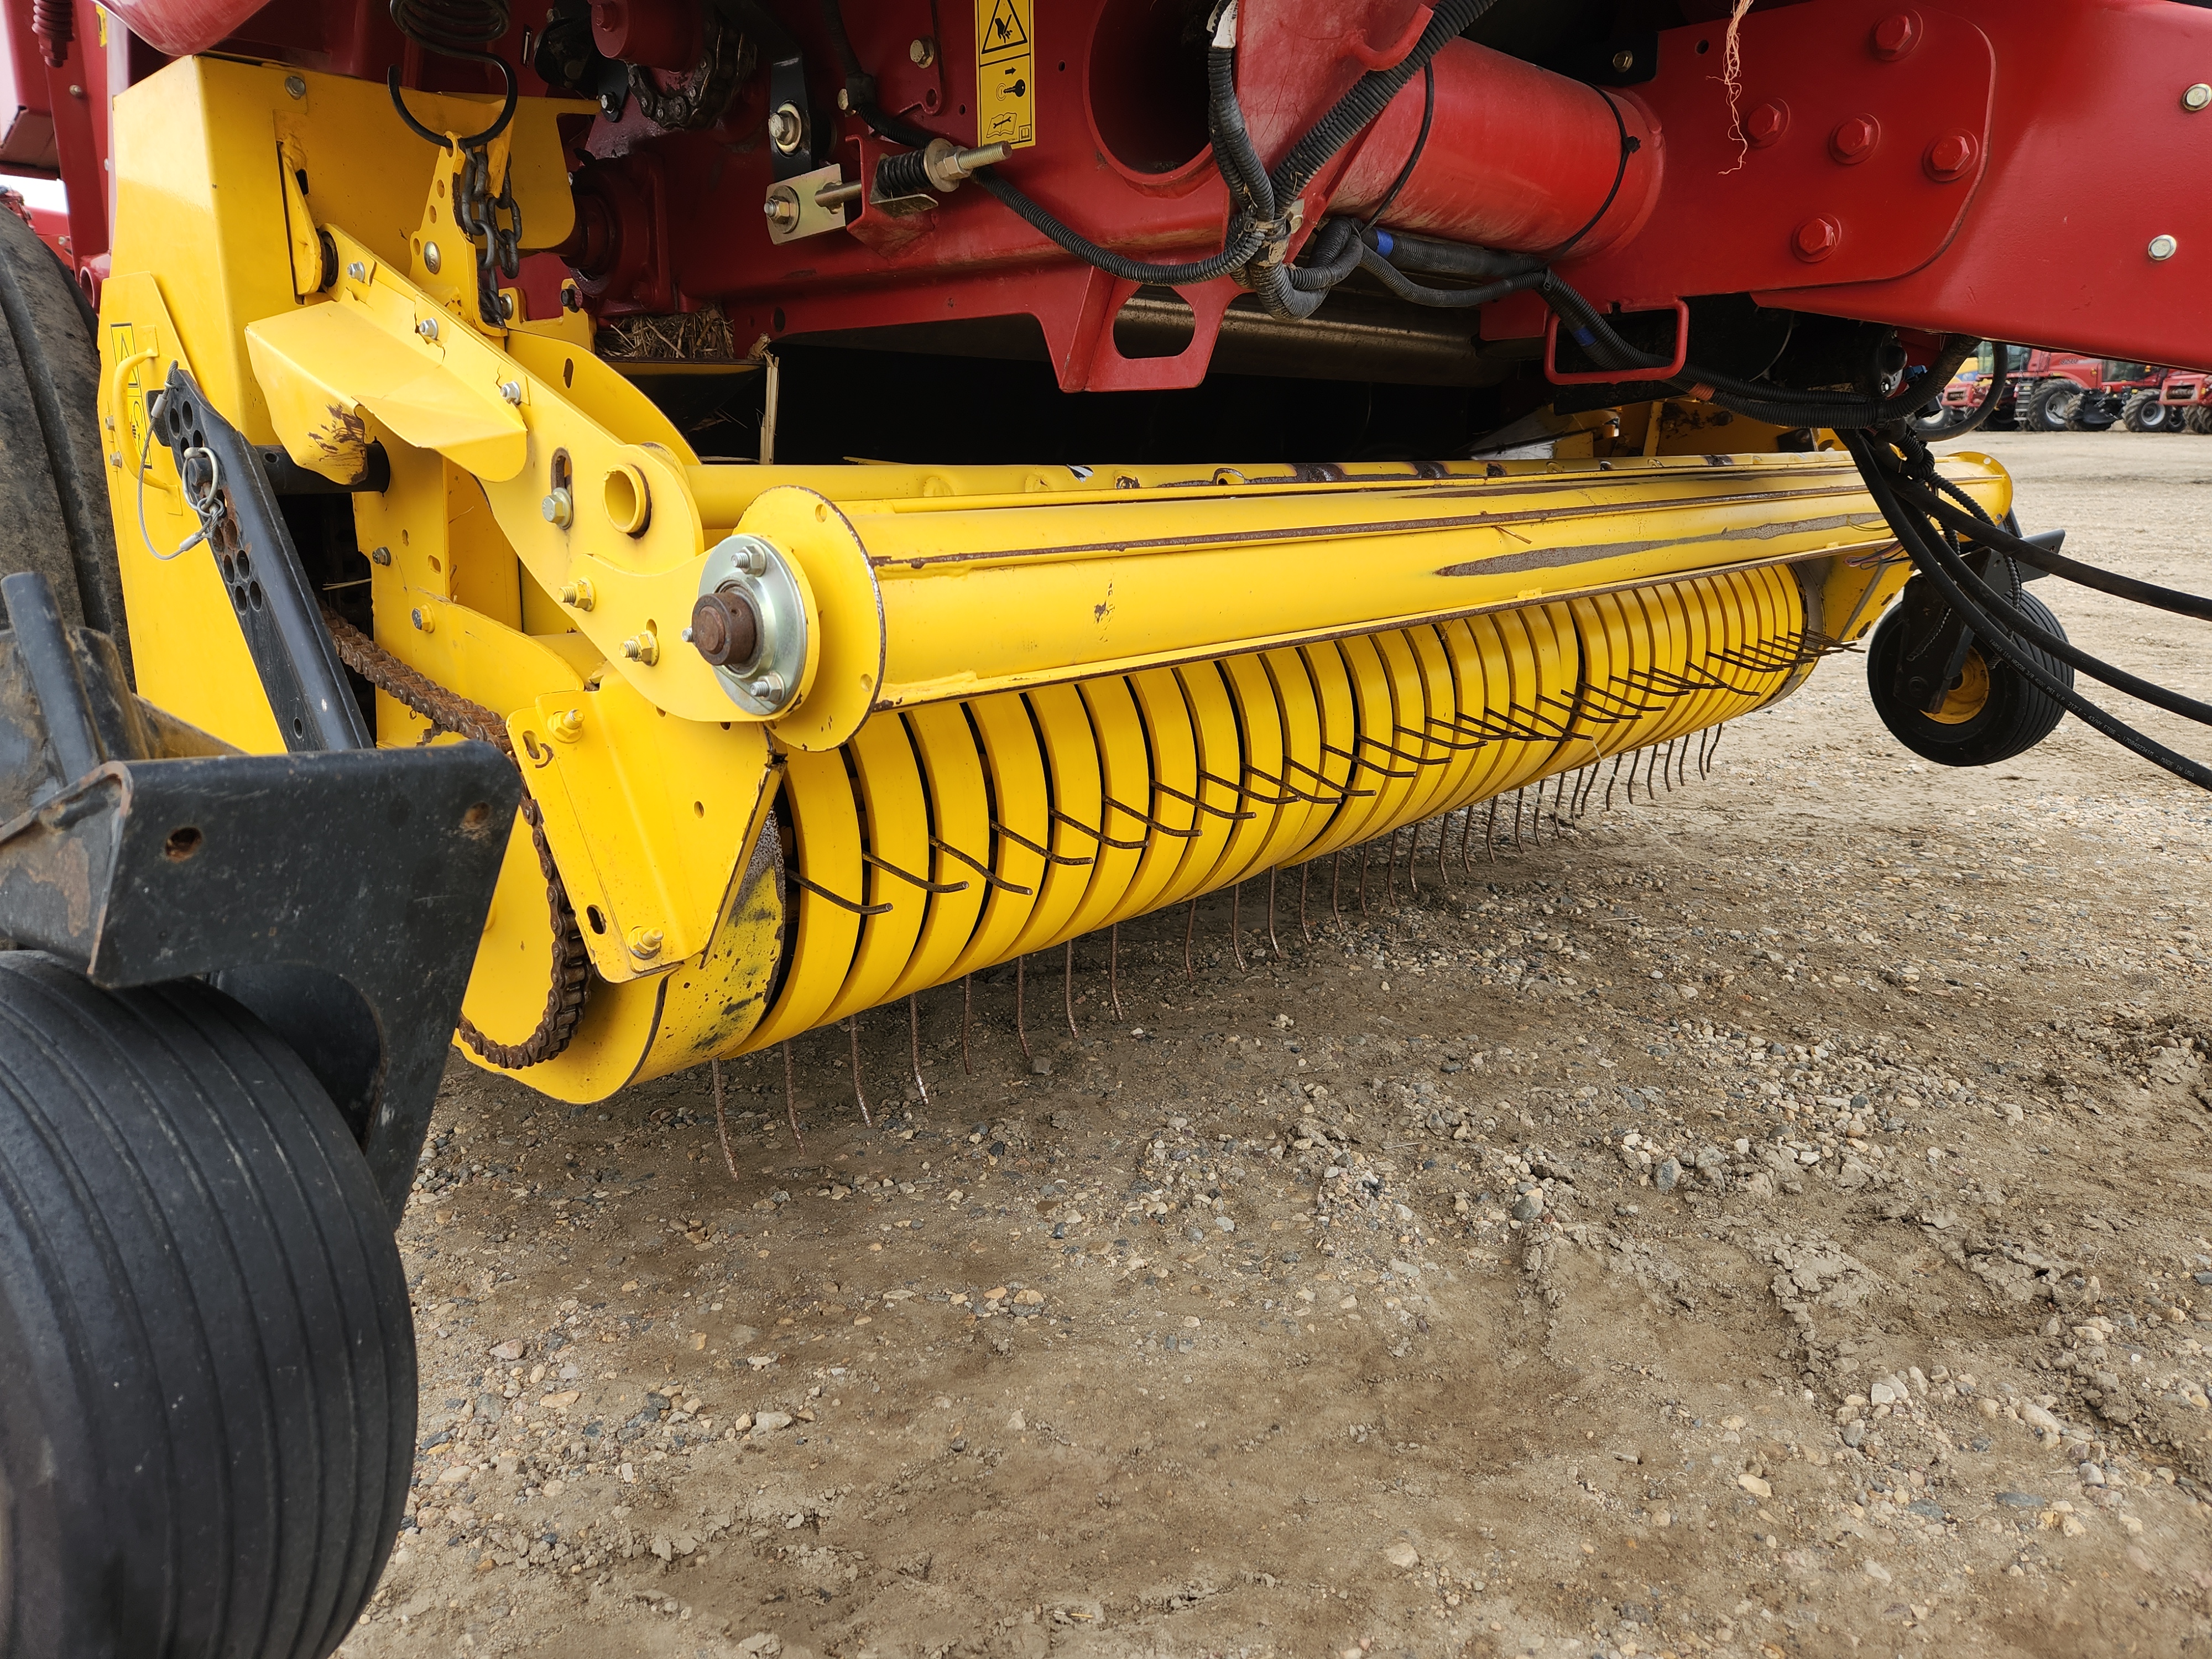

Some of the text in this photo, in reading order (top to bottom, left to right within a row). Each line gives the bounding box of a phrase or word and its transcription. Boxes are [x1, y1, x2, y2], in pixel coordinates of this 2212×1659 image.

[2026, 671, 2034, 679] 3/8
[2035, 679, 2046, 687] 4000
[2046, 686, 2056, 695] PSI
[2088, 716, 2103, 726] 43/HY
[2103, 725, 2116, 734] FTGS
[2161, 757, 2174, 766] MADE
[2185, 769, 2195, 778] USA
